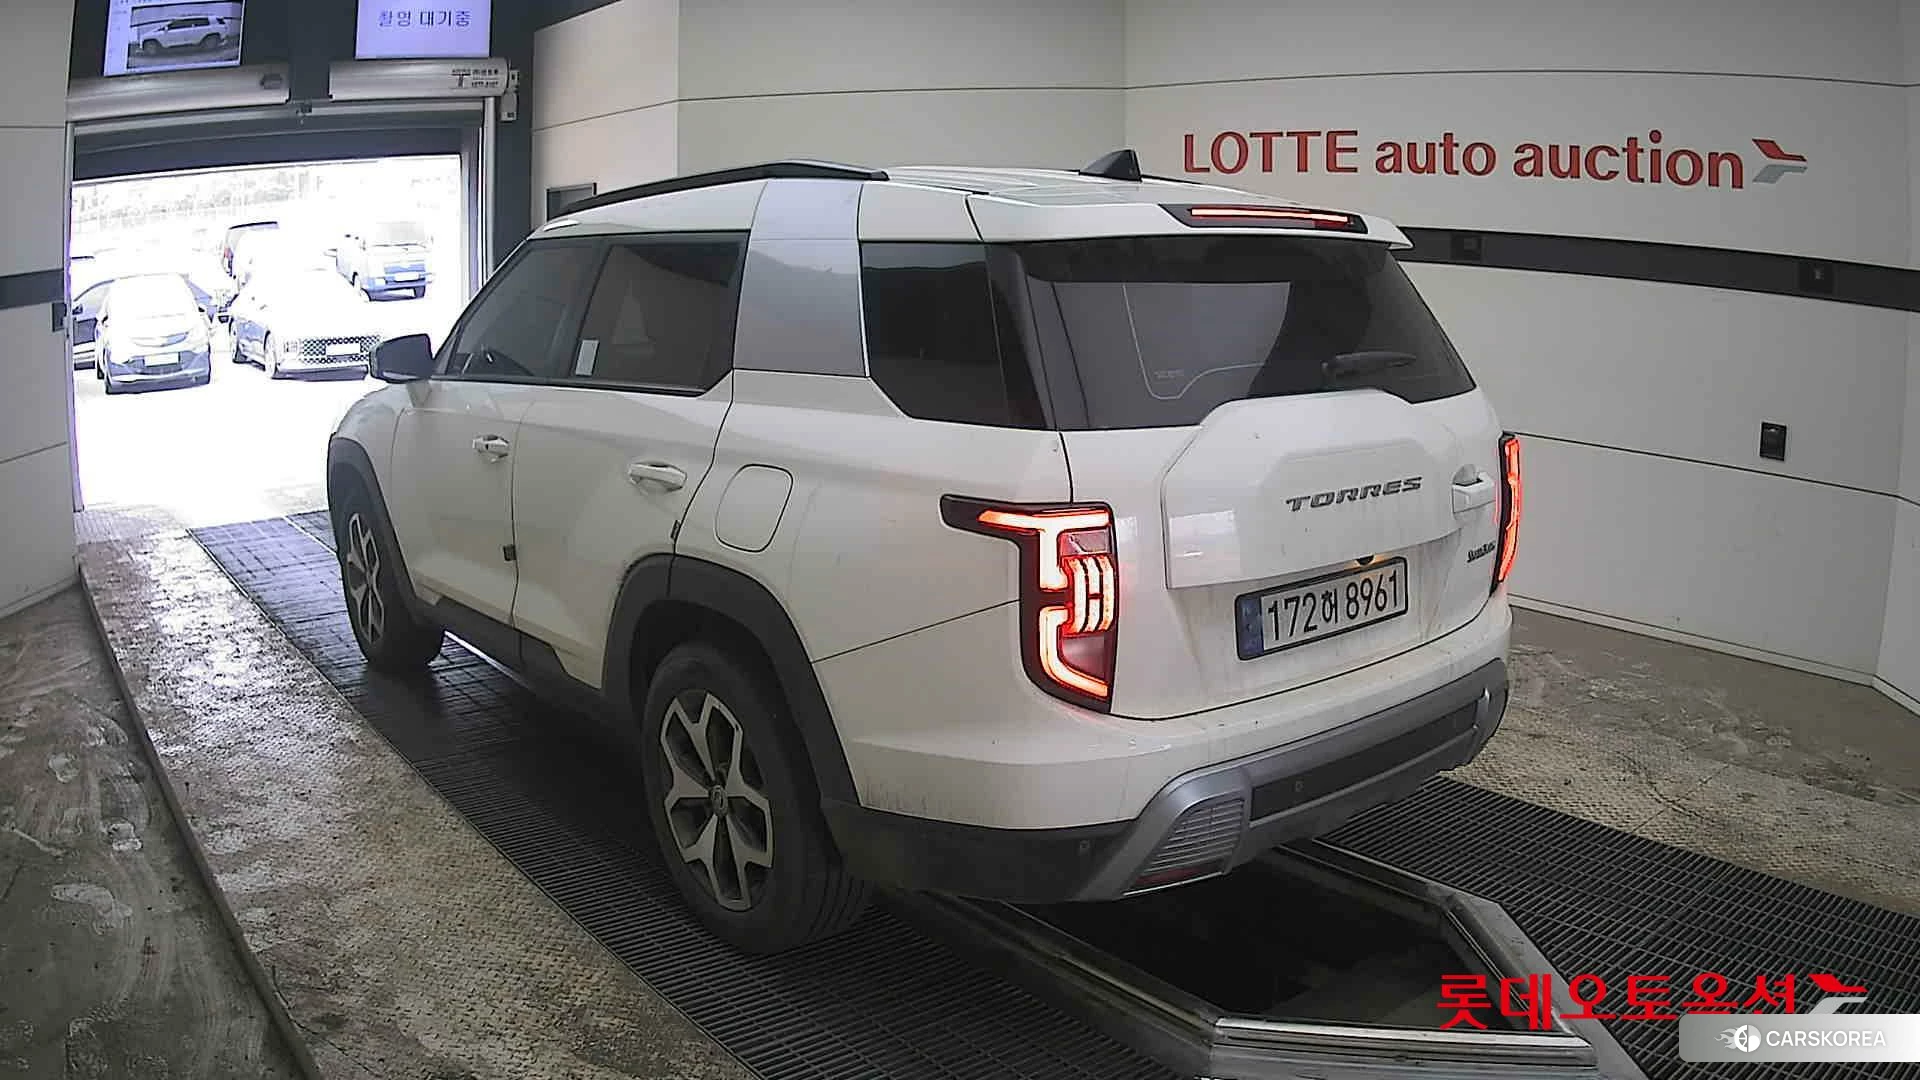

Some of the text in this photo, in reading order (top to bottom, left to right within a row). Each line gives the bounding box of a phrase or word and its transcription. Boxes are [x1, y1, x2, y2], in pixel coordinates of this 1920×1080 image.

[419, 9, 471, 27] 대기중
[1184, 130, 1744, 188] LOTTE auto auction
[1286, 476, 1422, 512] TORRES
[1267, 569, 1399, 641] 172허 8961
